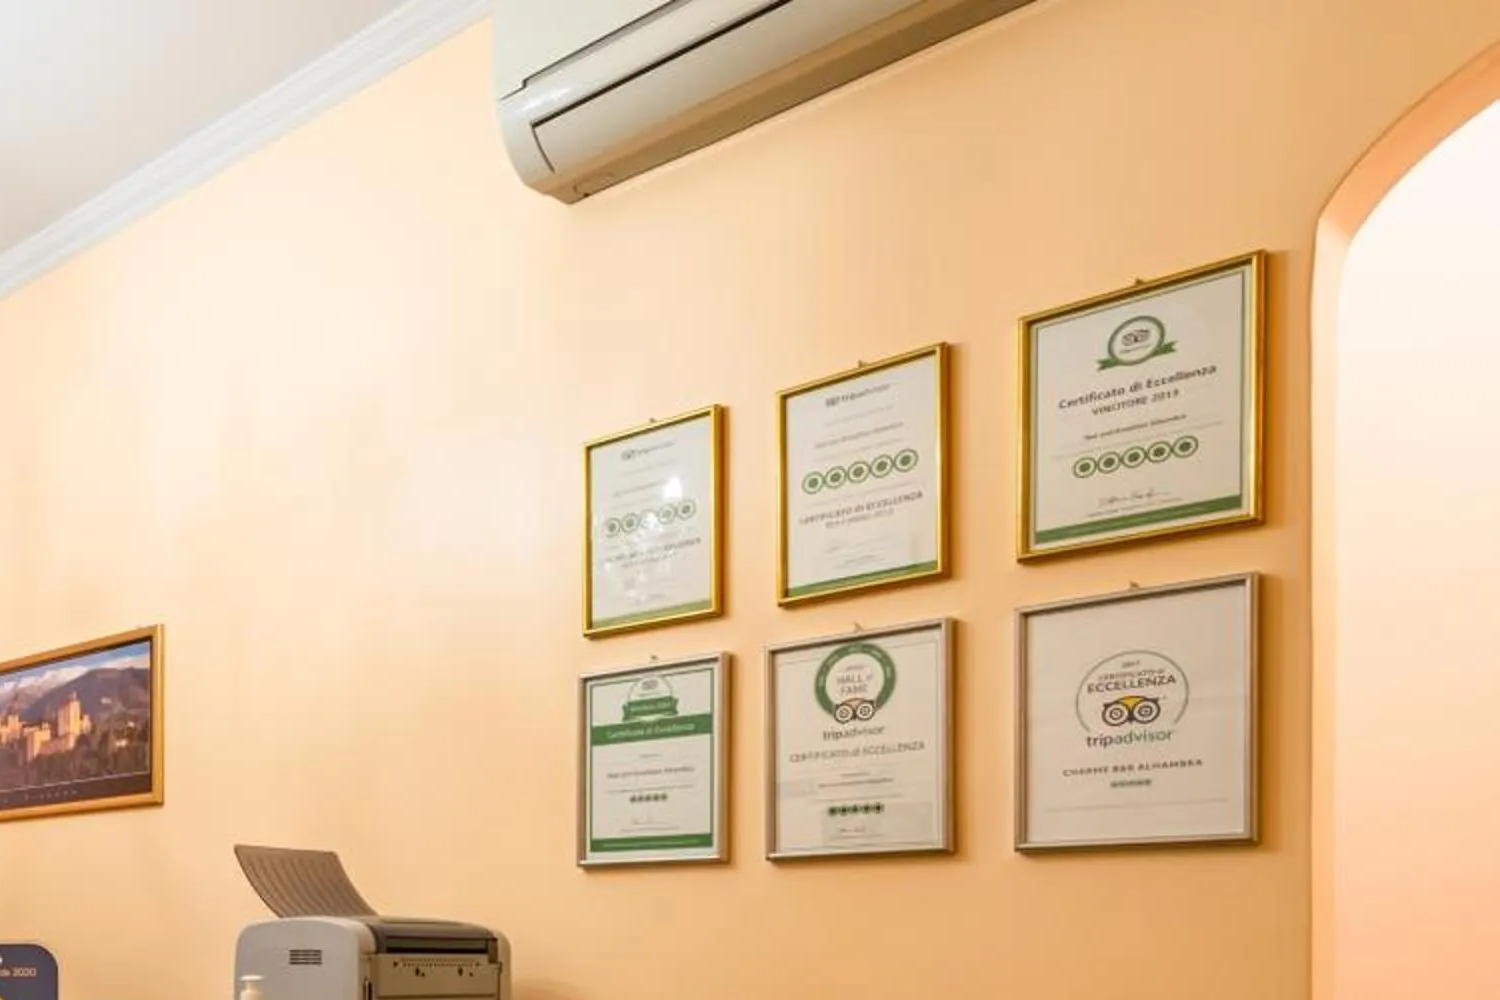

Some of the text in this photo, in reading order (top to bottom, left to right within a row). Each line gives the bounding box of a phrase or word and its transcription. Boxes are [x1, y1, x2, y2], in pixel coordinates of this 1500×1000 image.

[1059, 364, 1217, 410] Certificato di Eccellenza
[1087, 674, 1177, 694] ECCELLENZA
[822, 726, 885, 741] tripadvisor
[1086, 730, 1174, 749] tripadvisor
[1137, 758, 1203, 772] ALHAMBRA
[12, 967, 37, 977] 2020
